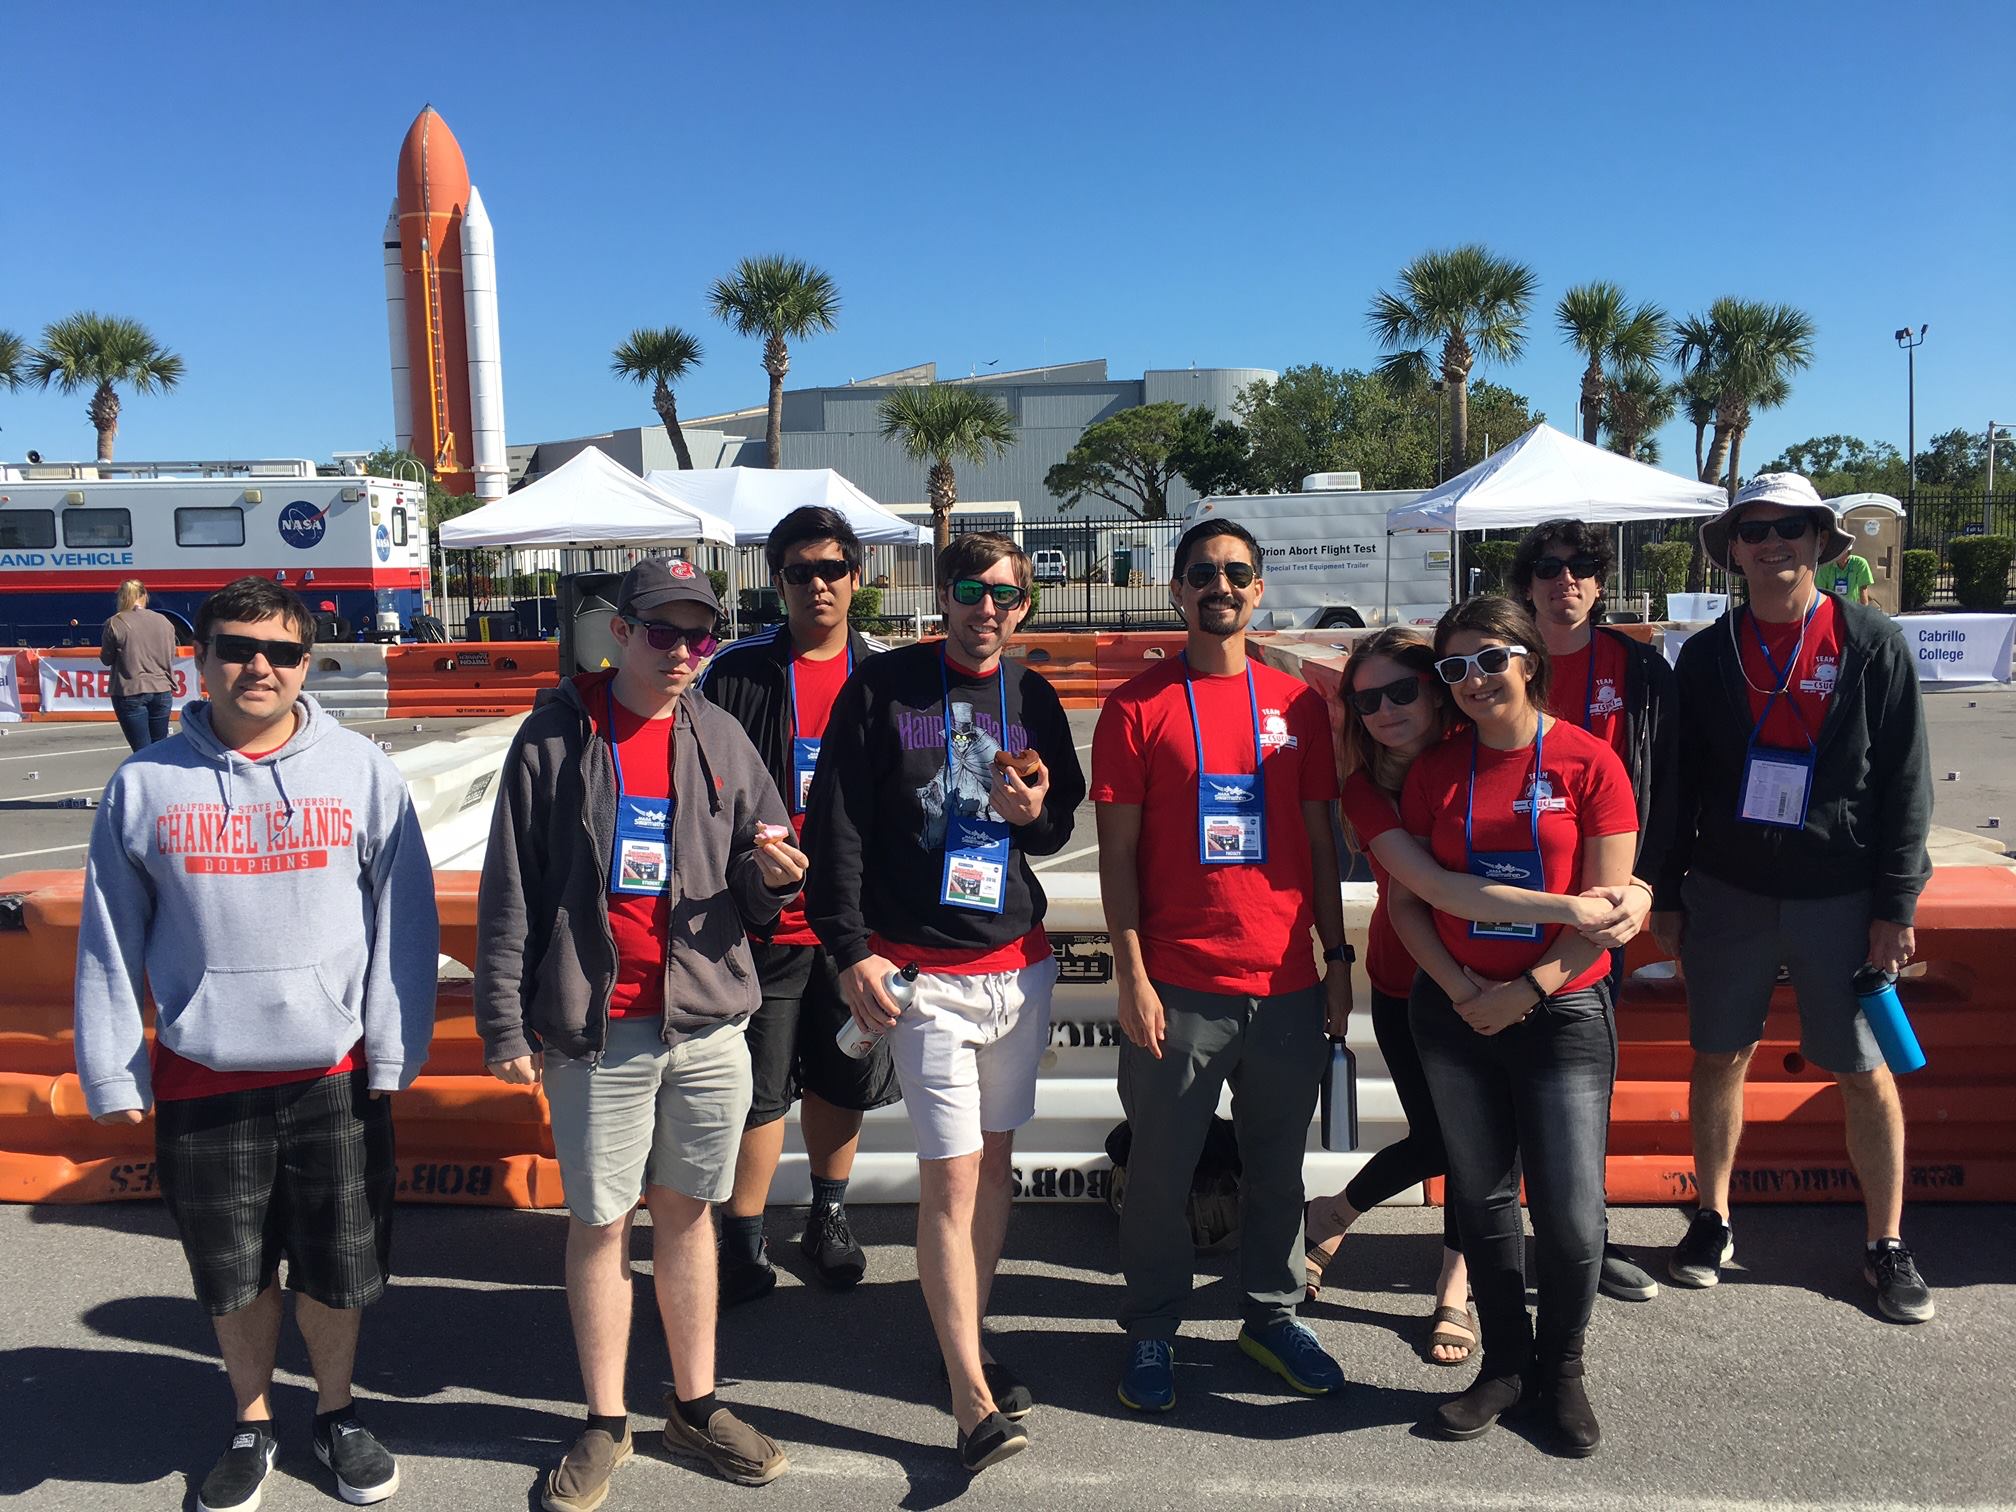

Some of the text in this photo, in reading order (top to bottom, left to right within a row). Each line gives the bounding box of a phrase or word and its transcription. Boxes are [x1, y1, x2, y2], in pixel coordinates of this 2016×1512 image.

[282, 519, 323, 531] NASA
[1260, 543, 1377, 556] Orion Abort Flight Test
[50, 552, 134, 566] VEHICLE
[1265, 564, 1291, 572] Special
[1309, 562, 1345, 571] Equipment
[1918, 629, 1966, 642] Cabrillo
[1815, 655, 1835, 663] TEAM
[1919, 647, 1964, 662] College
[54, 670, 111, 698] ARE
[1596, 678, 1614, 686] TEAM
[1814, 681, 1834, 690] CSUC
[1261, 708, 1280, 716] TEAM
[166, 797, 342, 814] CALIFORNI STATE UIVERSITY
[1527, 800, 1551, 808] CUCI
[156, 807, 353, 855] CHANNEL ISLANDS
[204, 857, 309, 872] DOLPHINS
